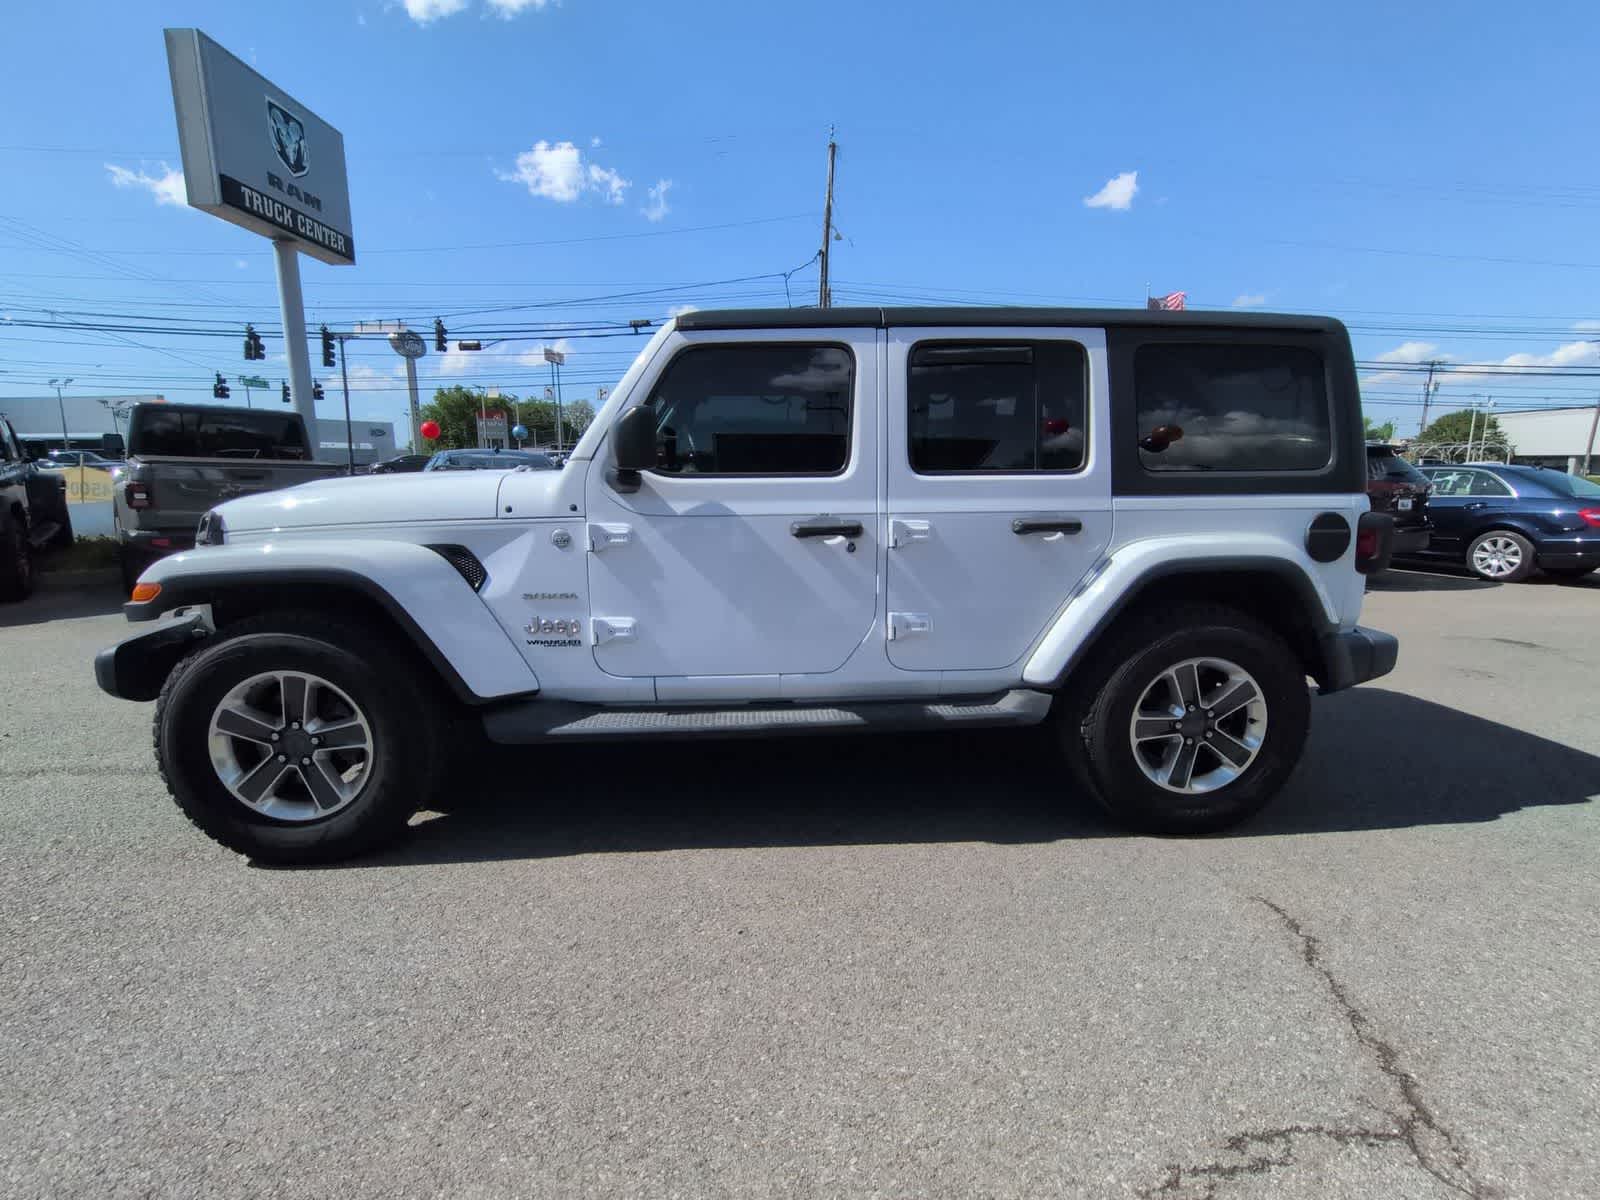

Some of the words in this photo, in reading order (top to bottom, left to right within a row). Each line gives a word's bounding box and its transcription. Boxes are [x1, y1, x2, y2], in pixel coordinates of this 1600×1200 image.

[267, 171, 322, 211] RAM
[241, 186, 293, 227] TRUCK
[297, 214, 345, 252] CENTER
[523, 615, 581, 637] Jeep
